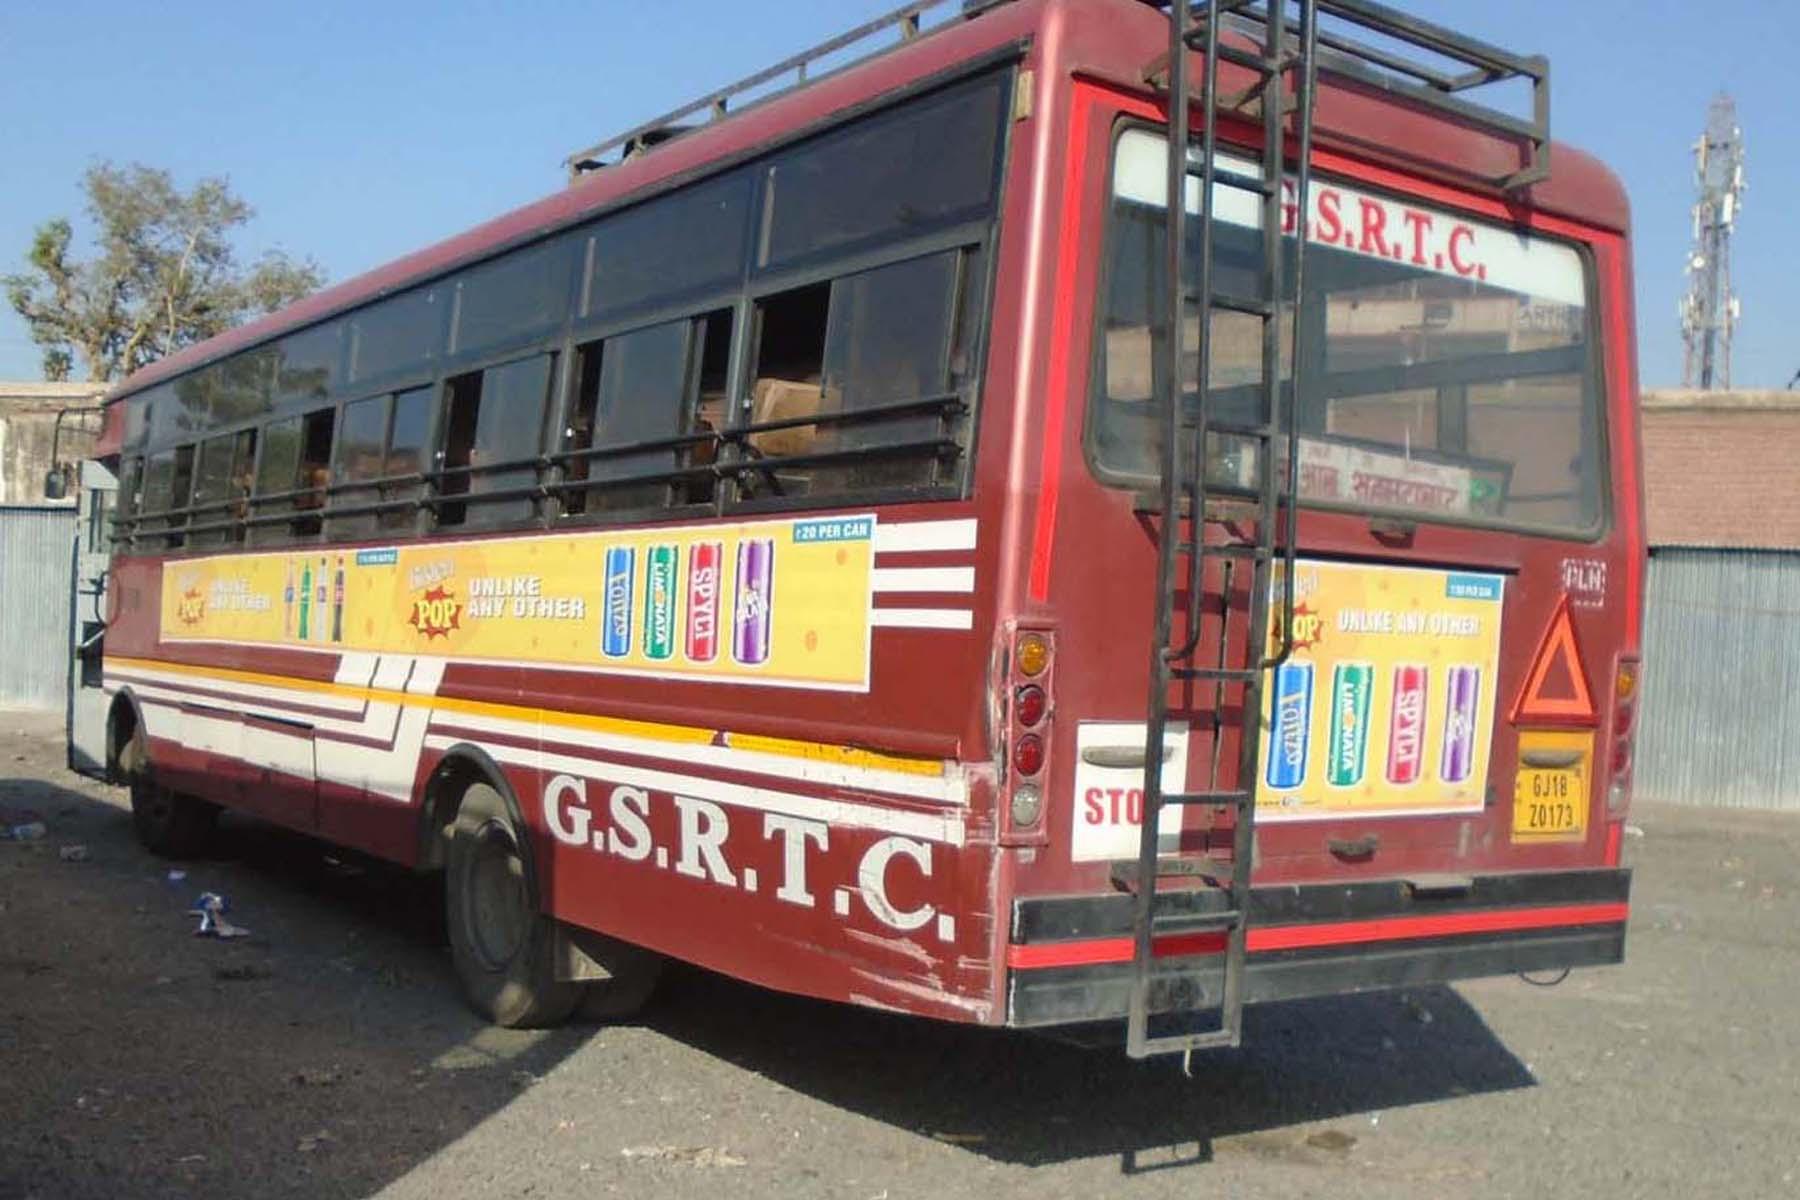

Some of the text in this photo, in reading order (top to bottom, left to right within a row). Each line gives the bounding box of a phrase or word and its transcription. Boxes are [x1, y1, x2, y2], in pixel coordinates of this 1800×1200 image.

[819, 524, 841, 539] PER
[843, 522, 868, 537] CAN
[469, 576, 542, 597] UNLIKE
[417, 598, 456, 629] POP
[468, 597, 586, 619] ANY OTHER
[693, 566, 715, 640] SPYCI
[1532, 774, 1568, 799] GJ18
[1085, 787, 1150, 826] STO
[543, 774, 956, 942] G.S.R.T.C.
